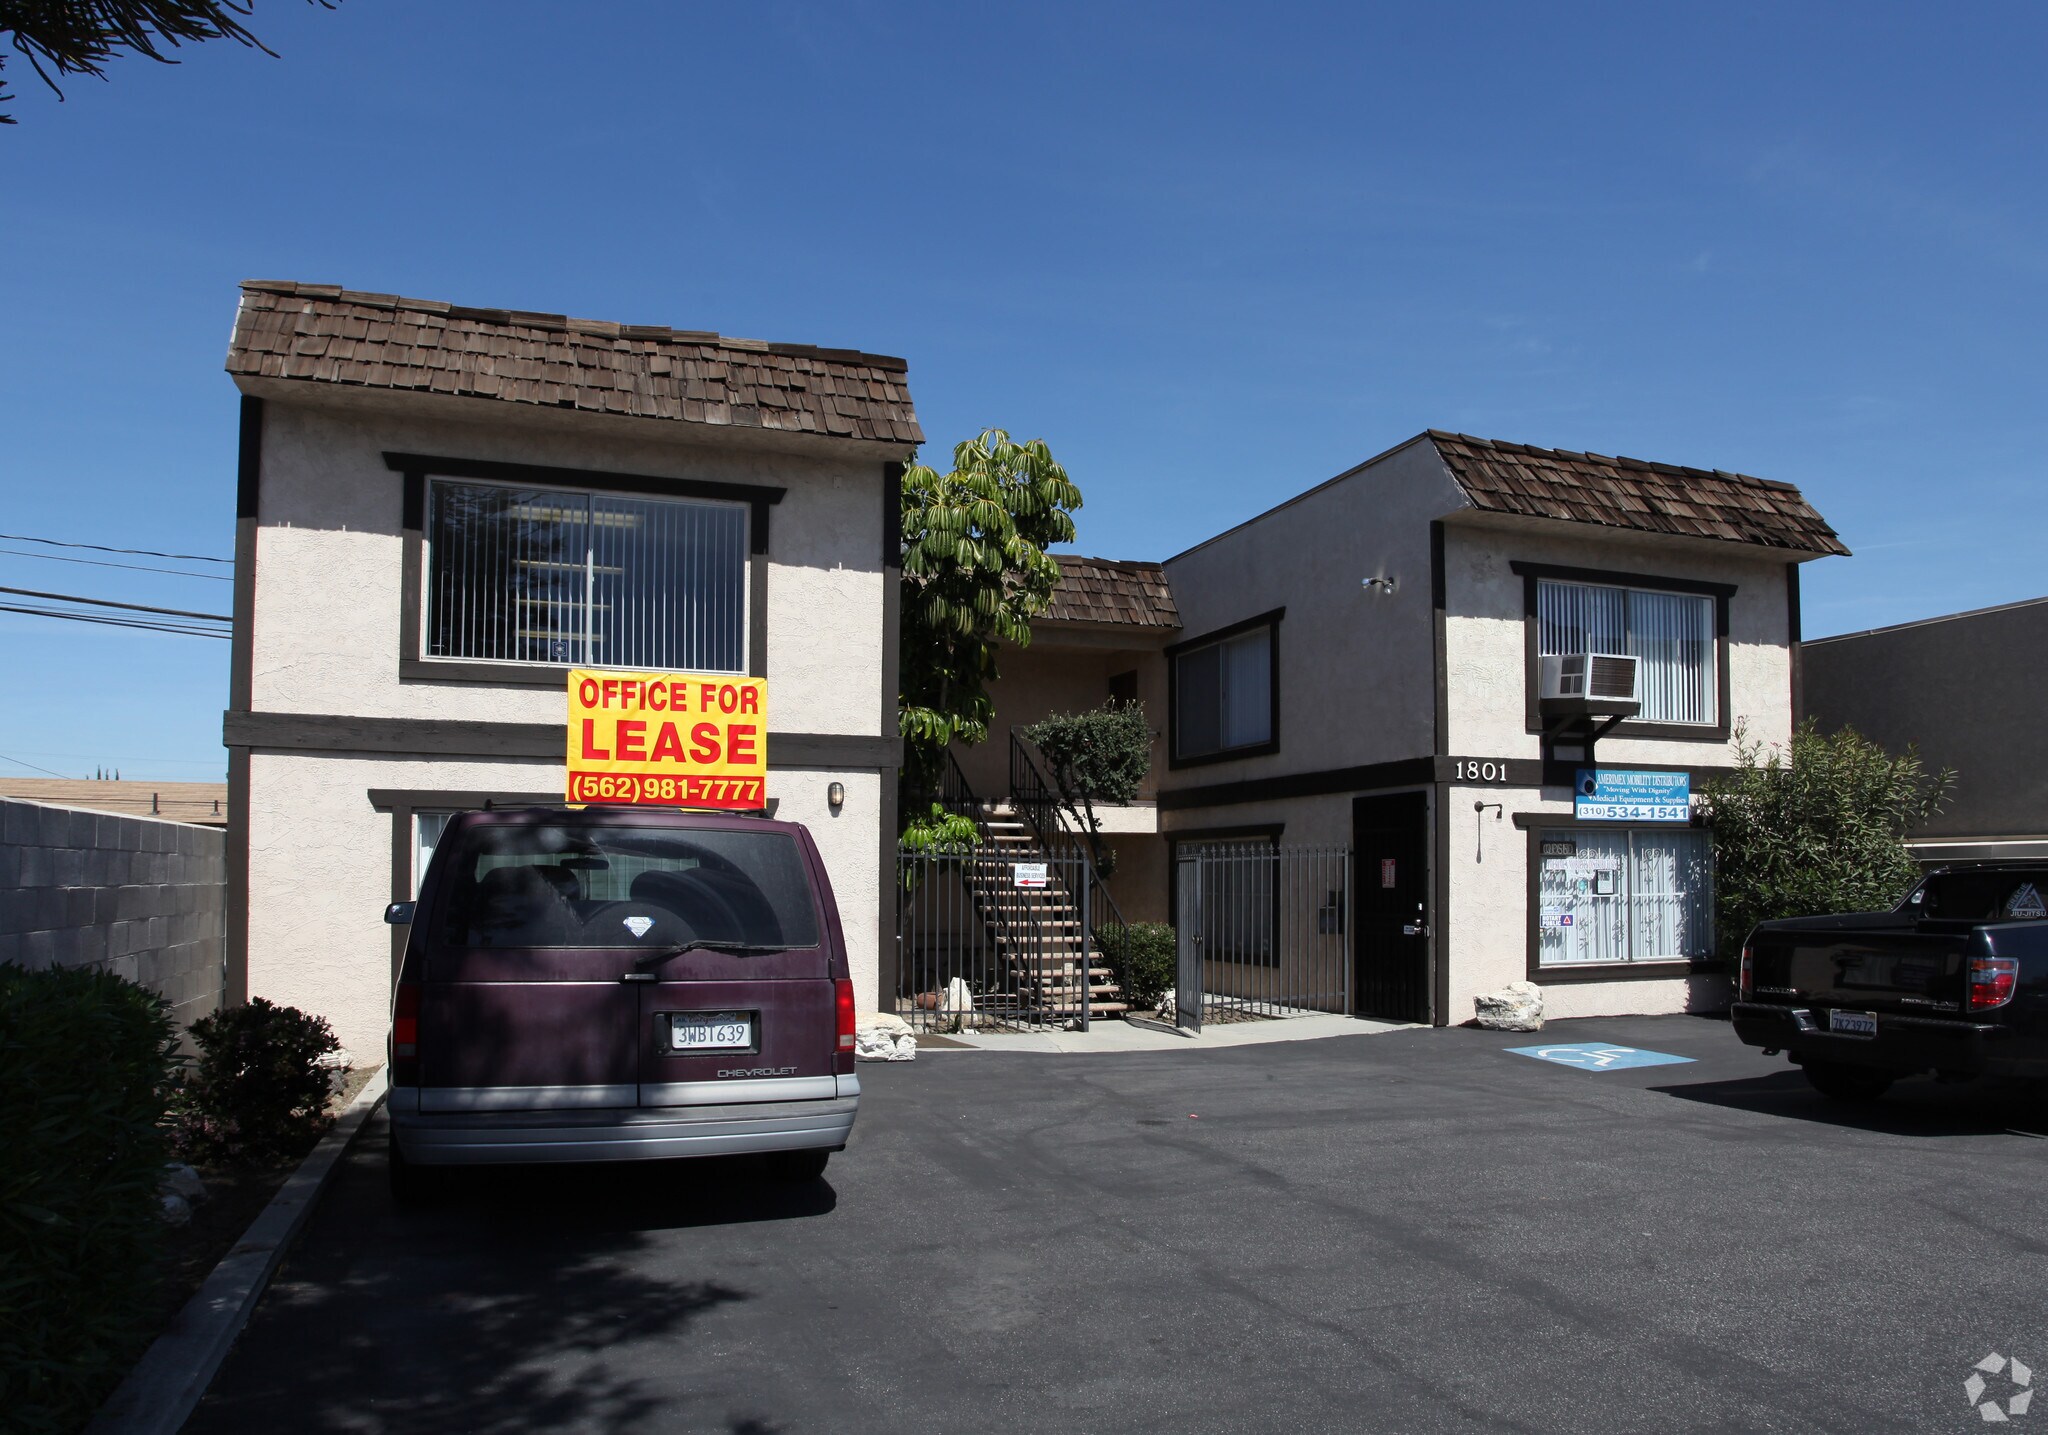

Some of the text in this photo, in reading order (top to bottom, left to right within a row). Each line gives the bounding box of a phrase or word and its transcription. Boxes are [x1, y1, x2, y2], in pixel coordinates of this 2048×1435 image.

[579, 678, 759, 715] OFFICE FOR
[582, 718, 757, 765] LEASE
[1456, 761, 1507, 781] 1801
[1597, 773, 1687, 787] AMERIMEX MOBILITY DISTRIBUTORS
[1619, 796, 1654, 804] Equipment
[1662, 797, 1686, 805] Supplies
[2006, 882, 2029, 910] GRACIE
[717, 1066, 798, 1078] CHEVROLET
